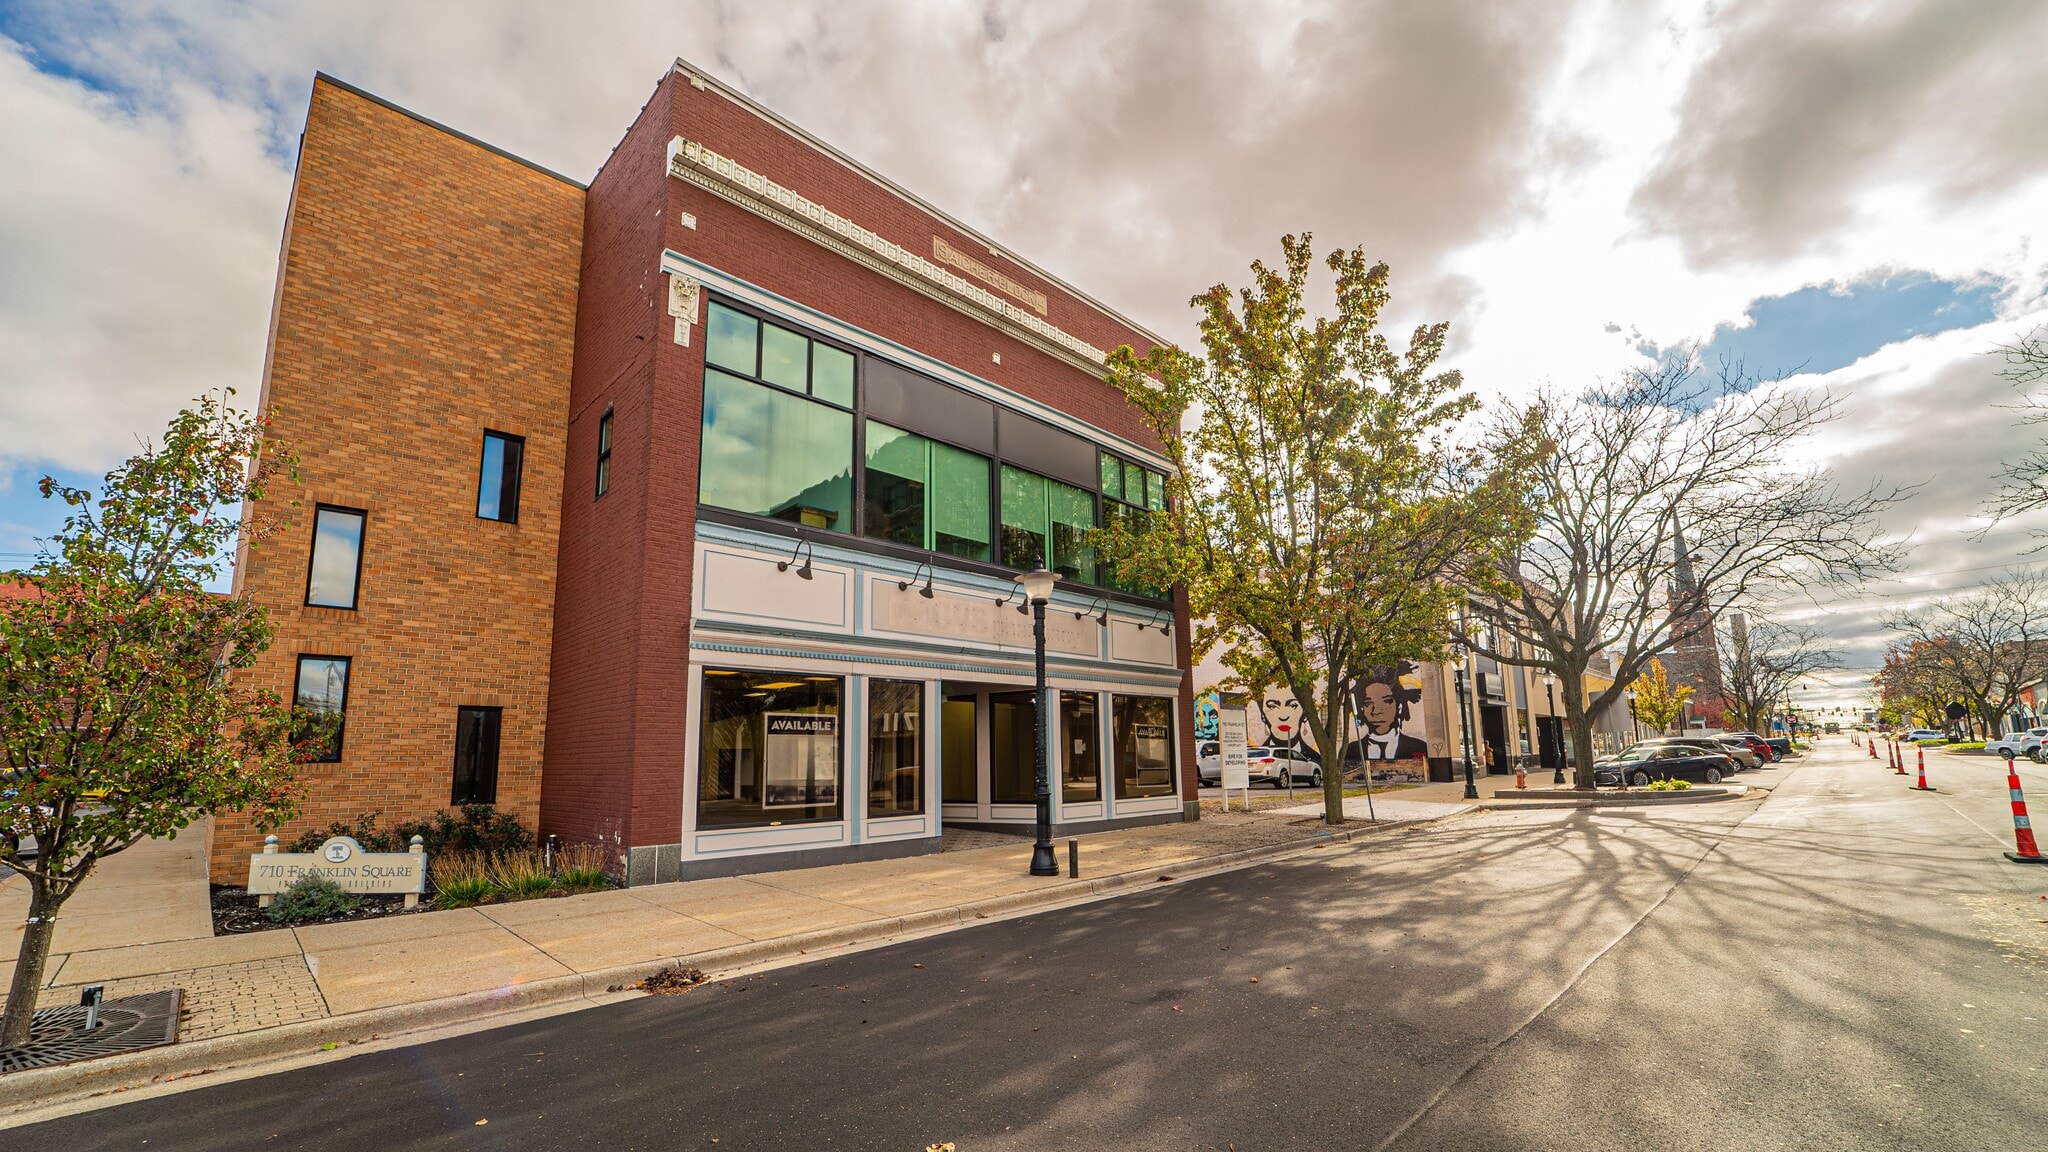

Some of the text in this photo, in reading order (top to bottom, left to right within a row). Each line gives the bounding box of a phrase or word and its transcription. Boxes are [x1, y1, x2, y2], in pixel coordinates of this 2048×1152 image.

[771, 720, 832, 731] AVAILABLE
[260, 864, 412, 878] 710 FRANKLIN SQUARE
